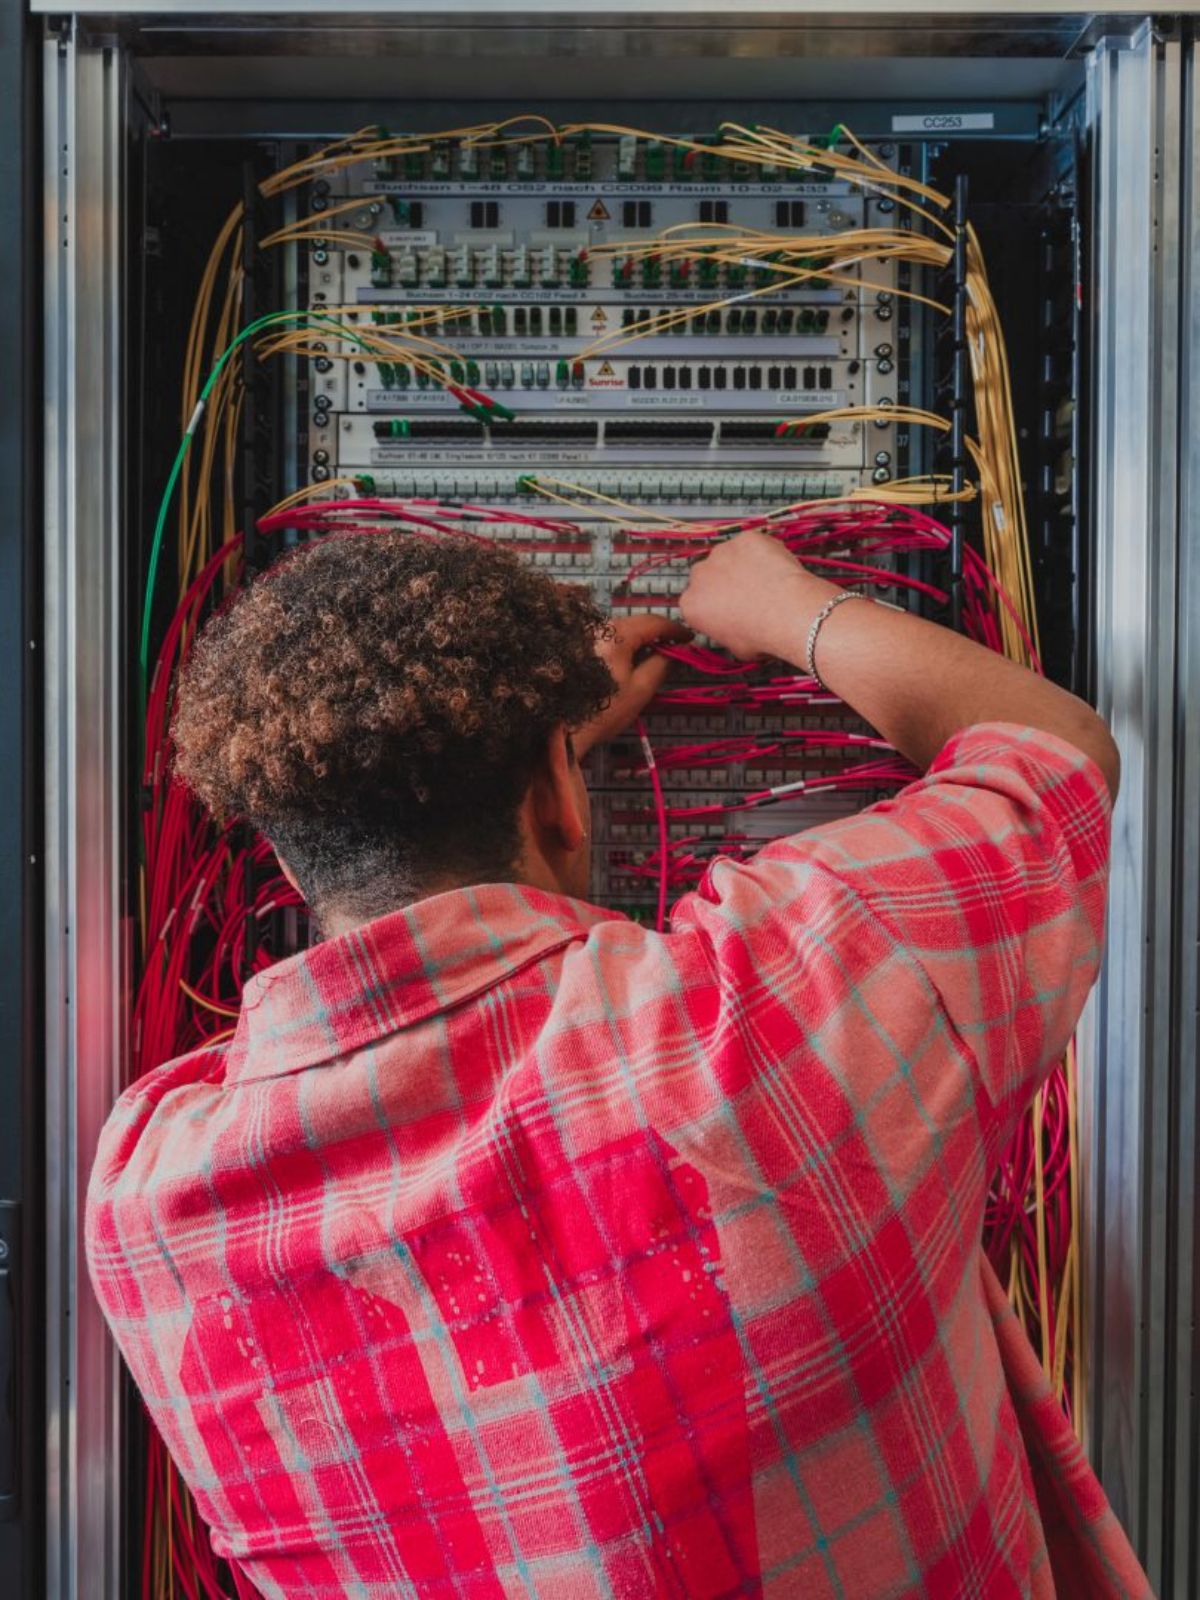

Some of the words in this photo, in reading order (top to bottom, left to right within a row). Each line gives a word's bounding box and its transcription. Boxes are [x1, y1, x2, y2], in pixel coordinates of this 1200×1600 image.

[923, 116, 962, 128] CC253
[374, 183, 451, 192] Buchsen
[552, 183, 596, 192] nach
[669, 184, 721, 193] Raum
[589, 377, 625, 387] Sunrise
